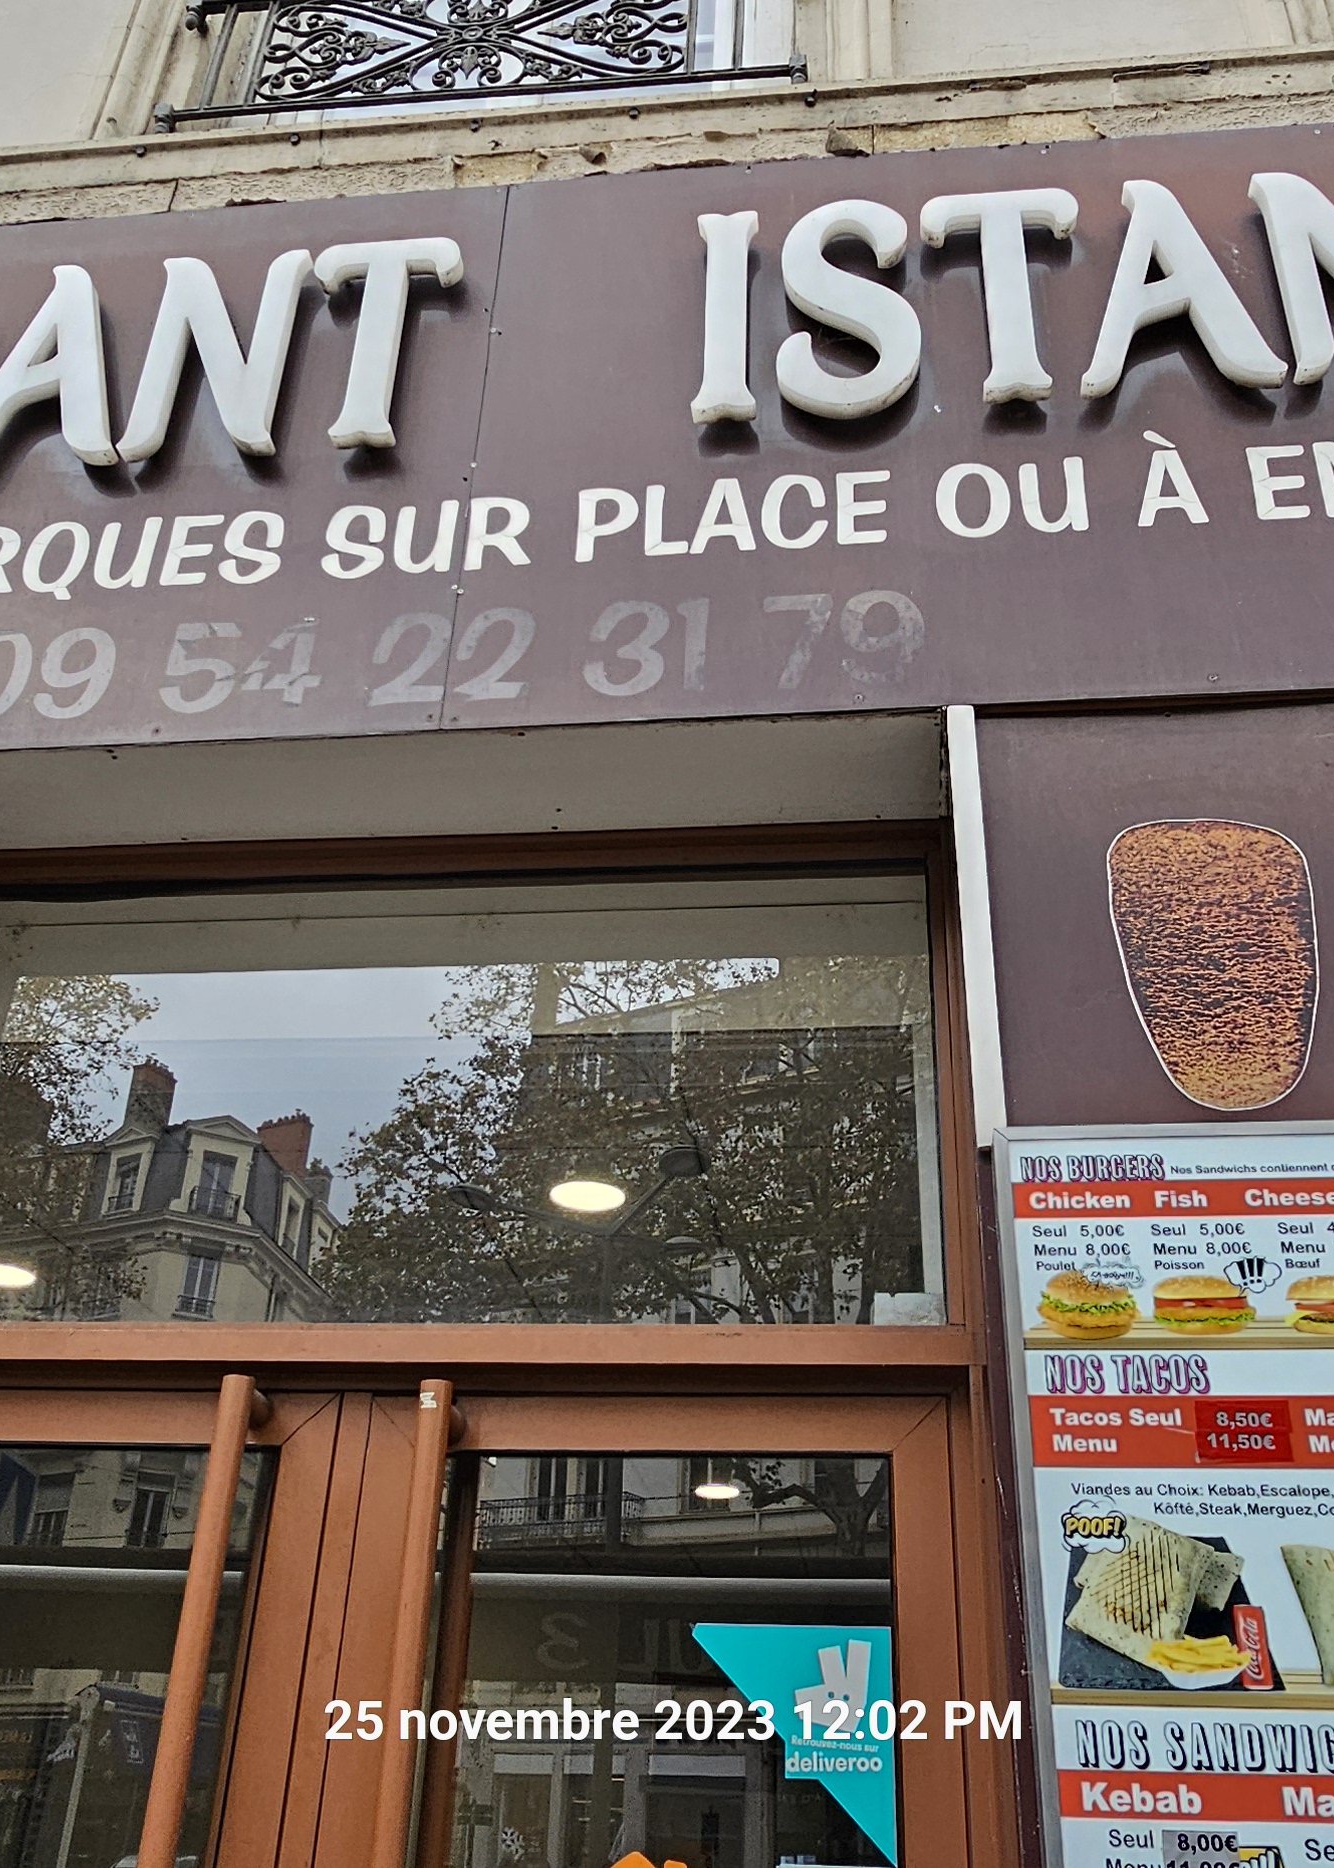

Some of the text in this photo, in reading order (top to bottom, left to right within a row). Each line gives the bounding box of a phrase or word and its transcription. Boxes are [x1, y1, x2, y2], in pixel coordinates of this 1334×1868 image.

[321, 497, 531, 580] SUR
[574, 470, 891, 563] PLACE
[935, 456, 1090, 538] OU
[1137, 430, 1210, 527] À
[158, 616, 320, 714] 54
[368, 607, 537, 706] 22
[582, 598, 709, 697] 31
[762, 589, 926, 690] 79
[1020, 1154, 1166, 1182] NOS BURGERS
[1170, 1165, 1192, 1174] Nos
[1195, 1164, 1257, 1174] Sandwichs
[1259, 1163, 1328, 1173] contiennent
[1029, 1191, 1131, 1210] Chicken
[1154, 1189, 1208, 1208] Fish
[1032, 1224, 1125, 1239] Seul 5,00€
[1150, 1223, 1245, 1238] Seul 5,00€
[1277, 1222, 1314, 1235] Seul
[1034, 1243, 1131, 1258] Menu 8,00€
[1153, 1242, 1252, 1257] Menu 8,00€
[1280, 1241, 1326, 1254] Menu
[1036, 1261, 1077, 1271] Poulet
[1154, 1259, 1205, 1270] Poisson
[1285, 1258, 1321, 1269] Bœuf
[1045, 1354, 1211, 1394] NOS TACOS
[1049, 1408, 1273, 1429] Tacos Seul 8,50€
[1052, 1432, 1276, 1452] Menu 11,50€
[1071, 1483, 1131, 1496] Viandes
[1135, 1486, 1153, 1496] au
[1157, 1483, 1204, 1496] Choix:
[1065, 1517, 1123, 1538] POOF!
[864, 1744, 879, 1753] sur
[1075, 1720, 1150, 1769] NOS
[786, 1751, 883, 1773] deliveroo
[1081, 1781, 1202, 1815] Kebab
[1109, 1829, 1238, 1855] Seul 8,00€
